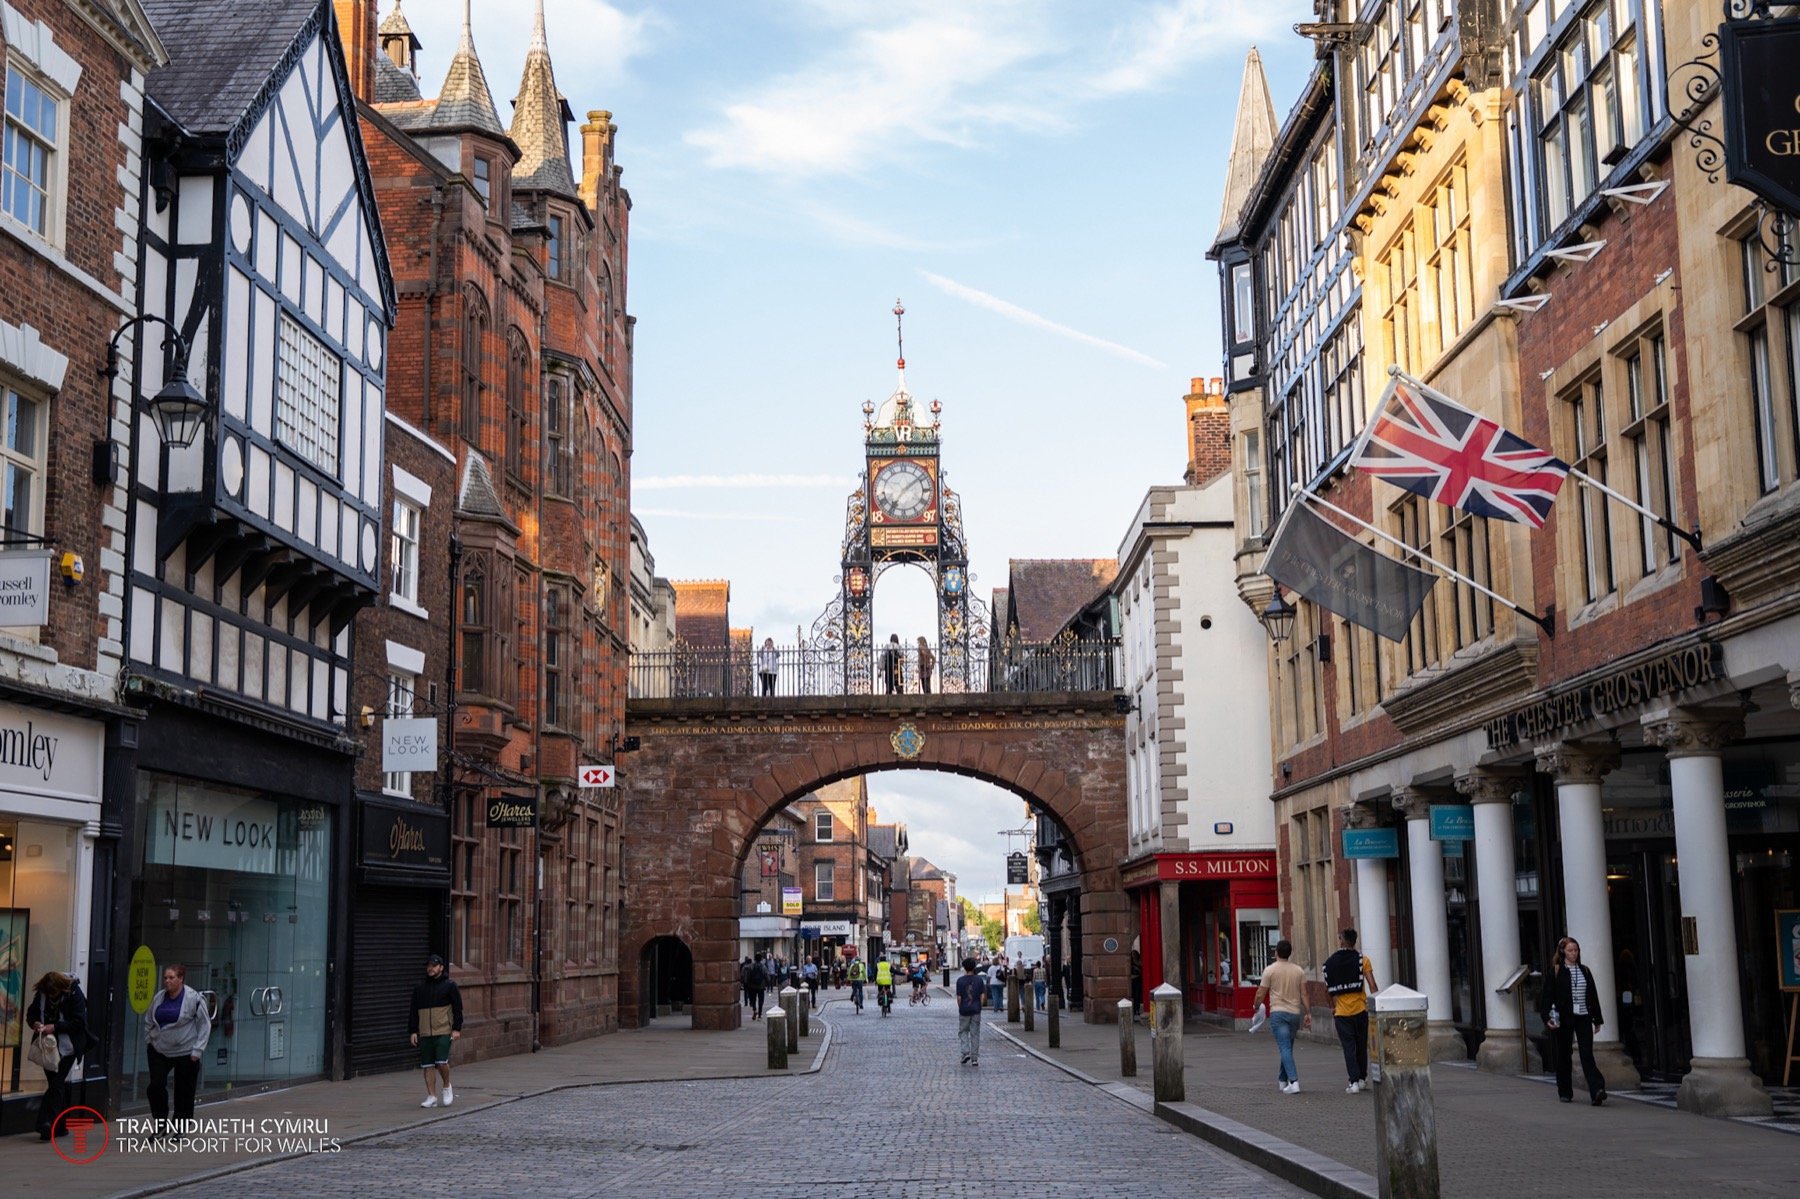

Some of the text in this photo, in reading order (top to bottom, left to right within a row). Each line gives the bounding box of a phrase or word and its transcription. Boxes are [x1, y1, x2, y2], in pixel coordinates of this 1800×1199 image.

[872, 510, 936, 523] 18 97
[1483, 642, 1716, 750] THE CHESTER GROSVENOR
[391, 735, 427, 745] NEW
[0, 720, 59, 782] mley
[388, 745, 430, 756] LOOK
[165, 809, 273, 849] NEW LOOK
[1175, 861, 1202, 875] S.S.
[1207, 859, 1270, 874] MILTON
[823, 924, 846, 932] ISLAND
